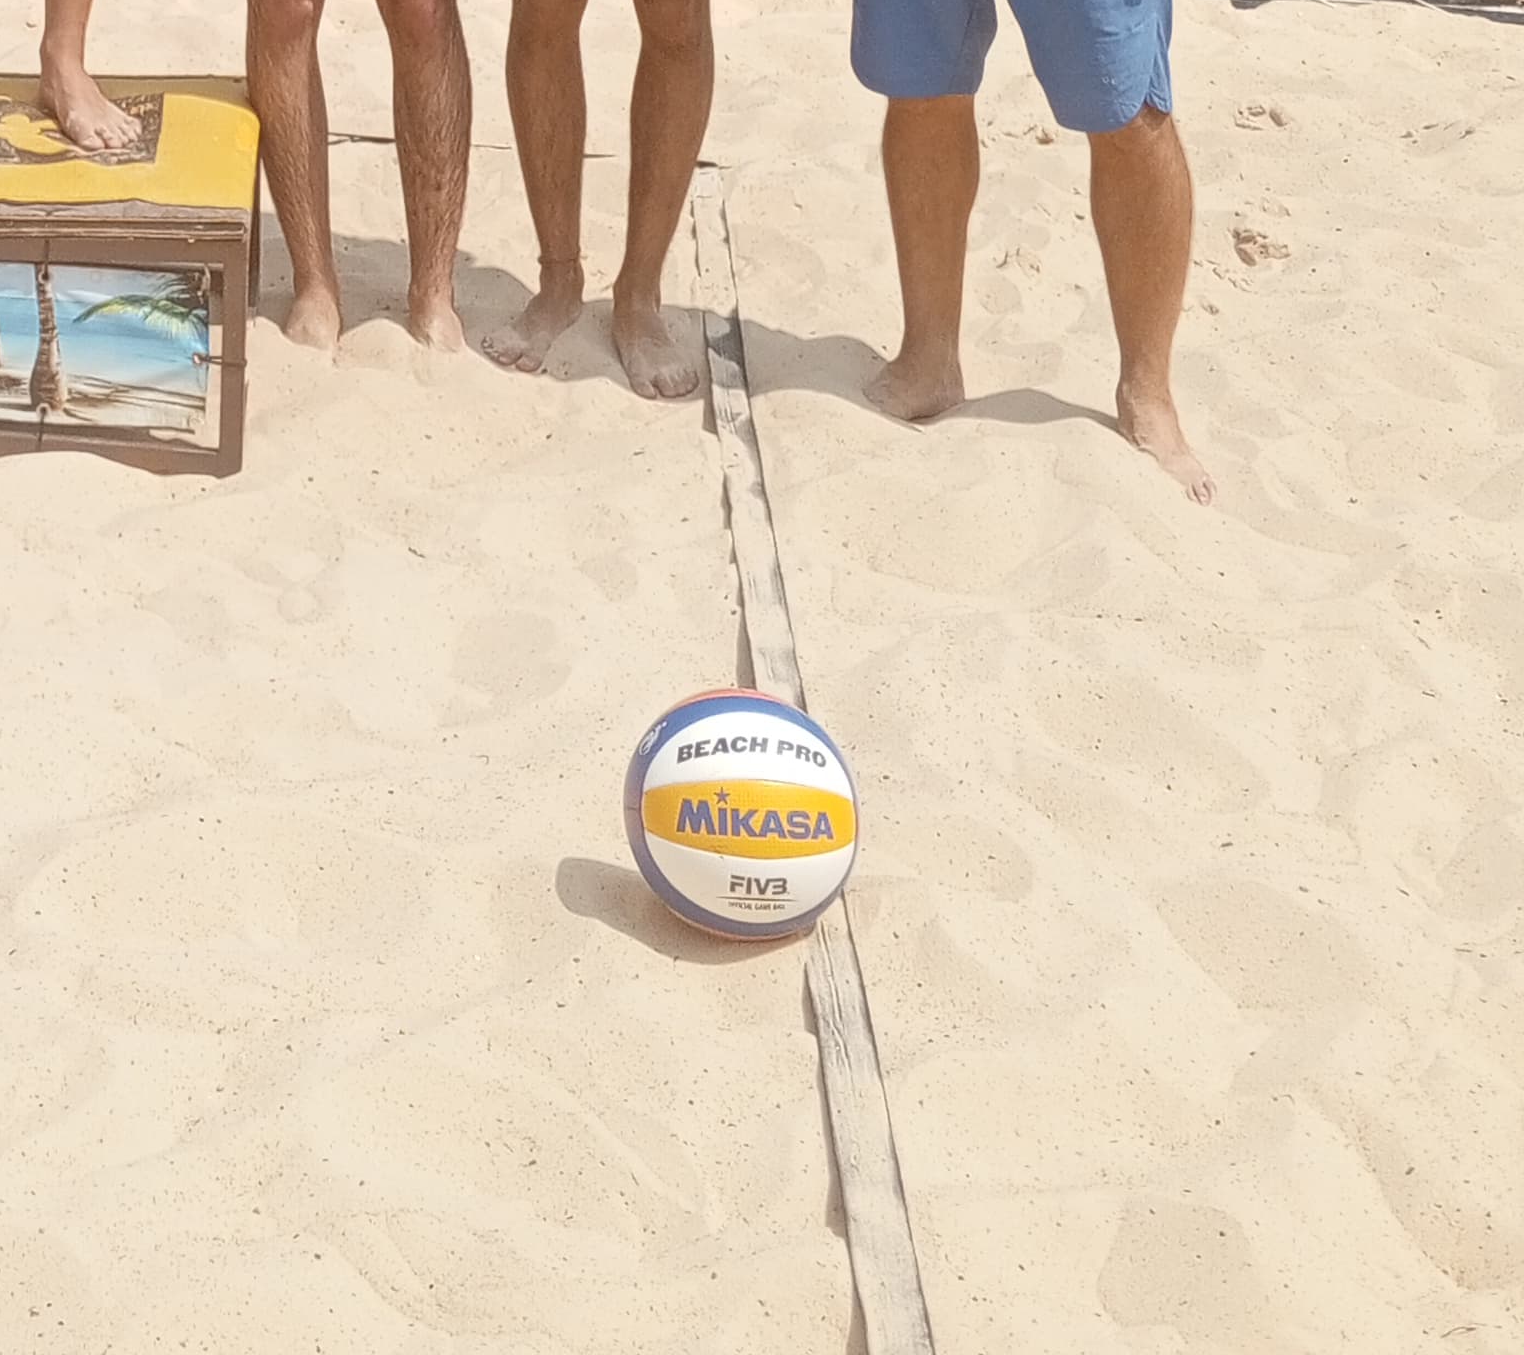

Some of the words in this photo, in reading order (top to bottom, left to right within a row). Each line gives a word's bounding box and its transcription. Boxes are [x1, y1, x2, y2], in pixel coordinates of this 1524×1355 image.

[677, 737, 768, 763] BEACH
[777, 739, 827, 768] PRO
[676, 794, 834, 840] MIKASA
